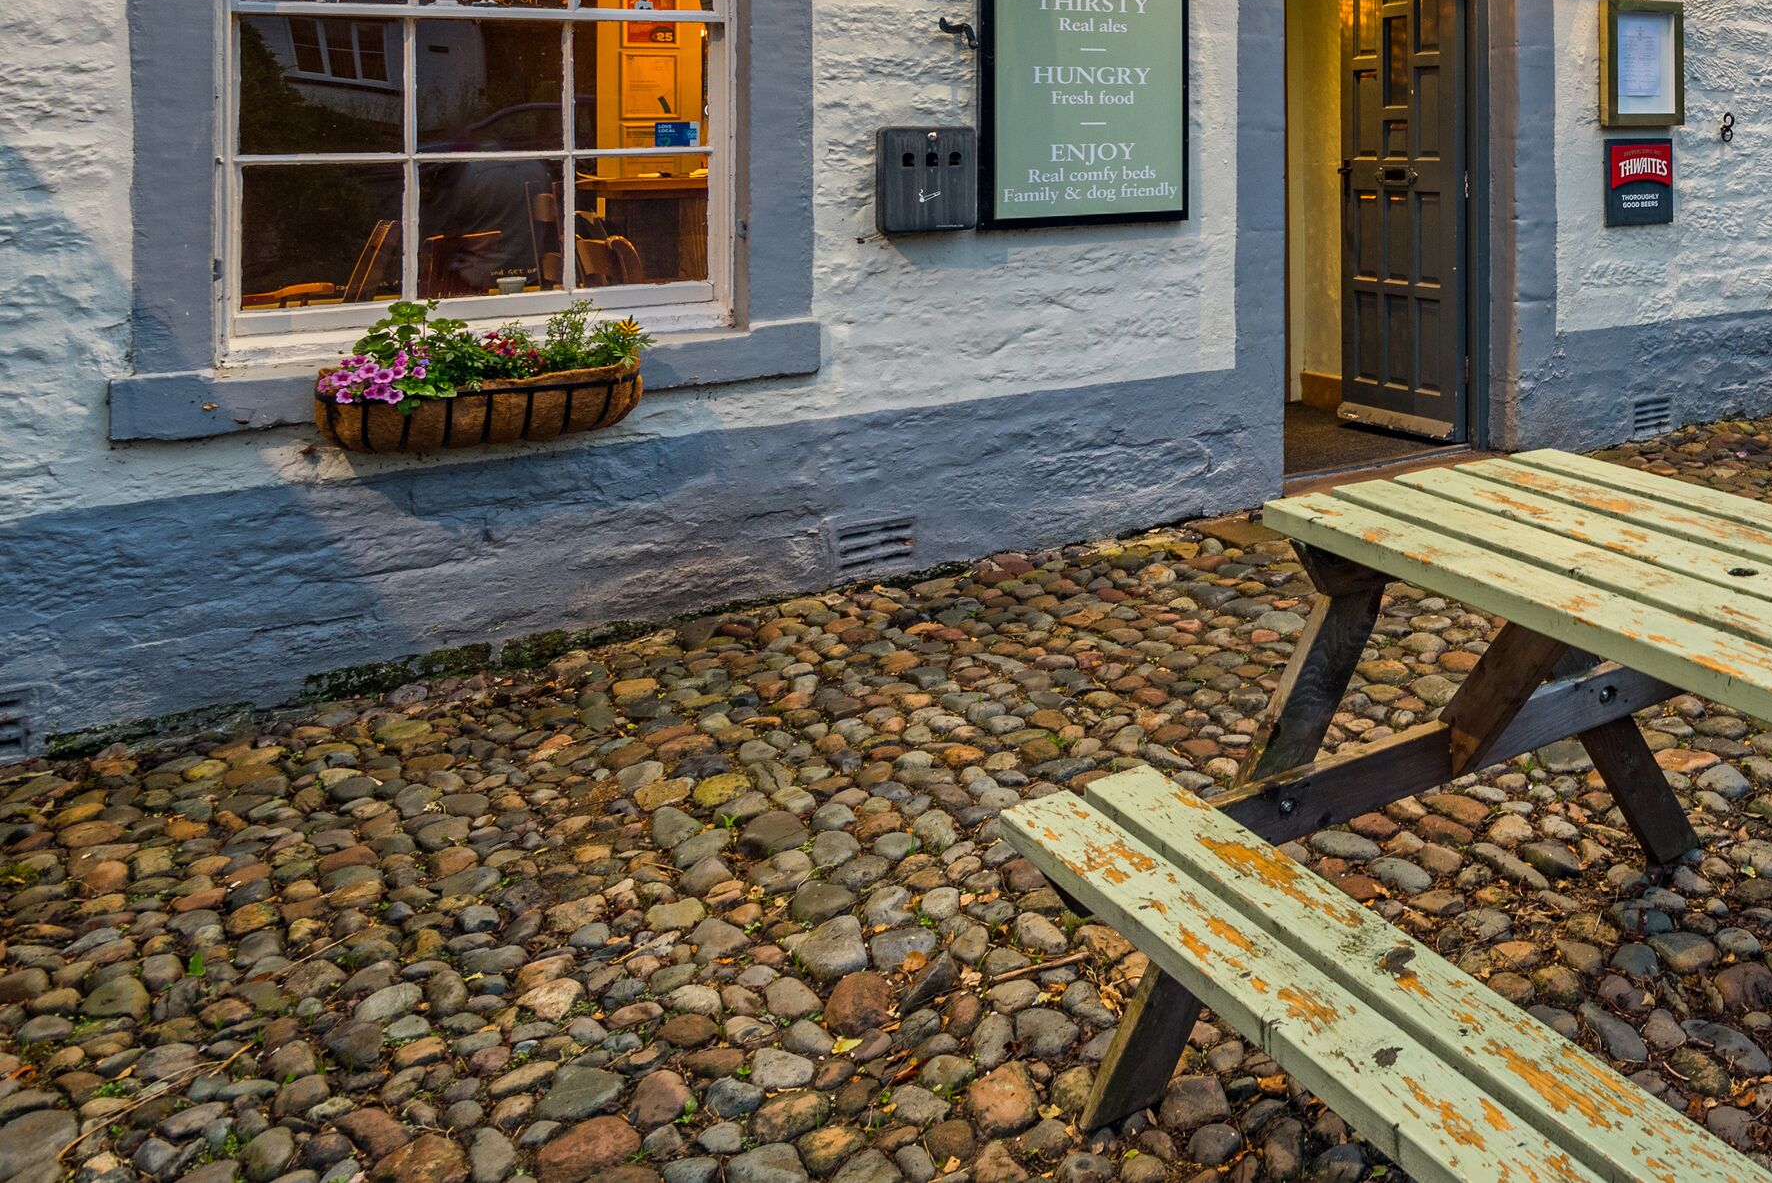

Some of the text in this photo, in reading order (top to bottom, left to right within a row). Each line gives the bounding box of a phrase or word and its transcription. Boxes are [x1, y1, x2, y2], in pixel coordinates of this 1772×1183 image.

[1058, 18, 1128, 33] Real ales
[656, 32, 673, 42] 25
[1032, 66, 1151, 85] HUNGRY
[1051, 90, 1134, 105] Fresh food
[1050, 142, 1136, 165] ENJOY
[1028, 165, 1156, 183] Real comfy beds
[1619, 157, 1668, 178] THWAITES
[1003, 182, 1178, 204] Family & dog friendly
